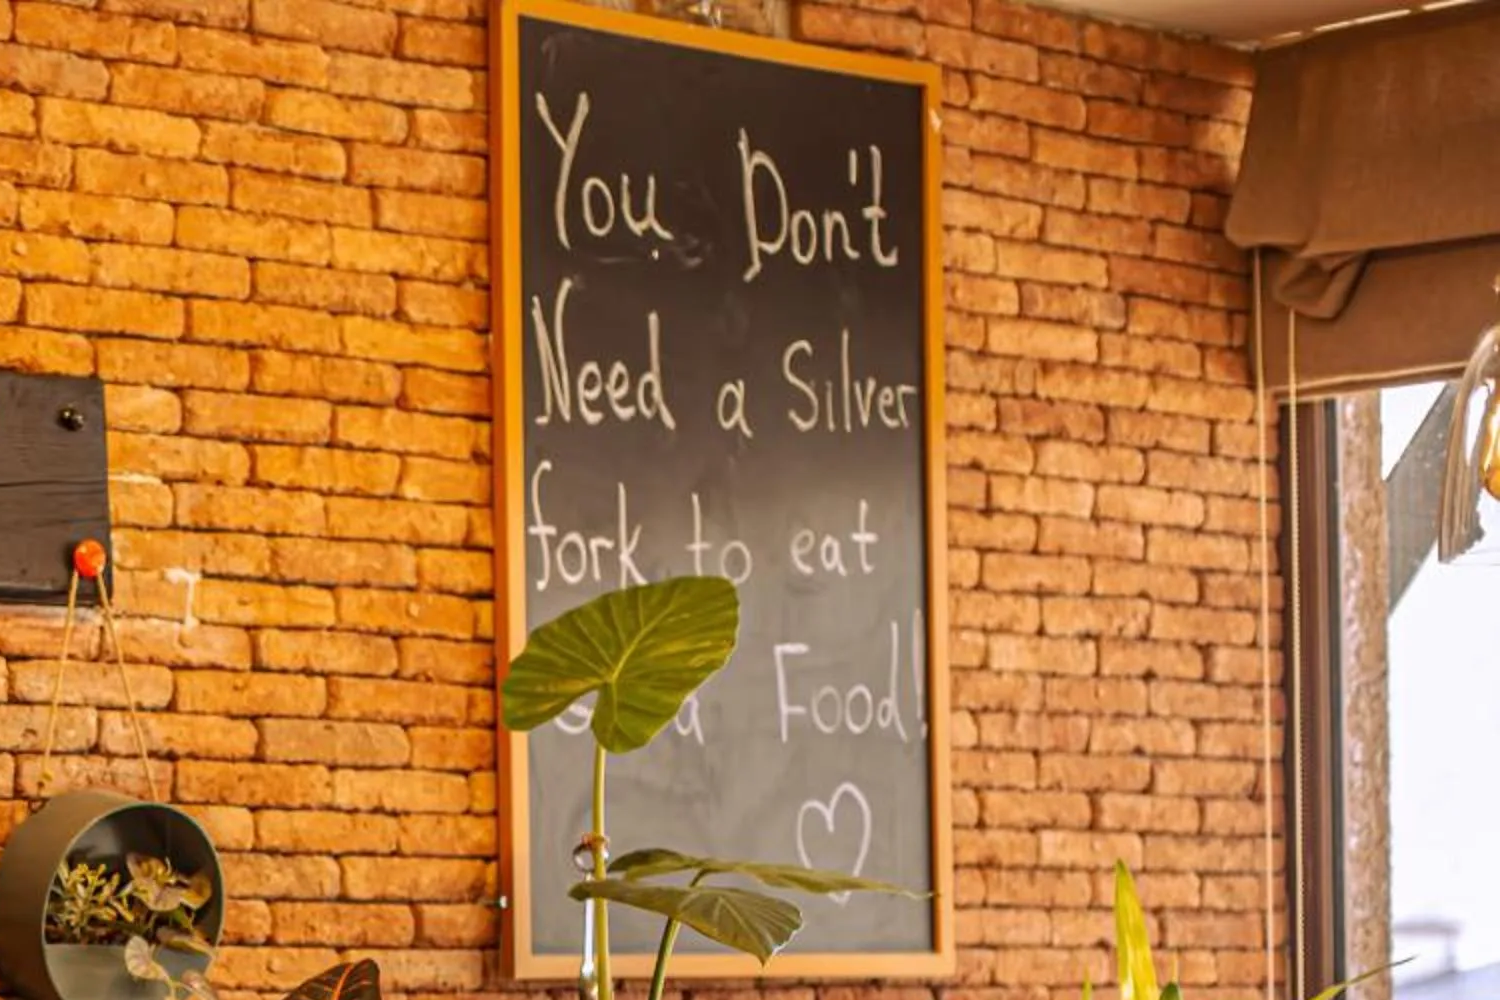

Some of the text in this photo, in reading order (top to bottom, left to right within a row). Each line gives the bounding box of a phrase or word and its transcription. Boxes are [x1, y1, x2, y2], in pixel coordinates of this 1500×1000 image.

[536, 92, 898, 283] You Don't
[531, 277, 917, 438] Need a Silver
[528, 460, 879, 590] fork to eat
